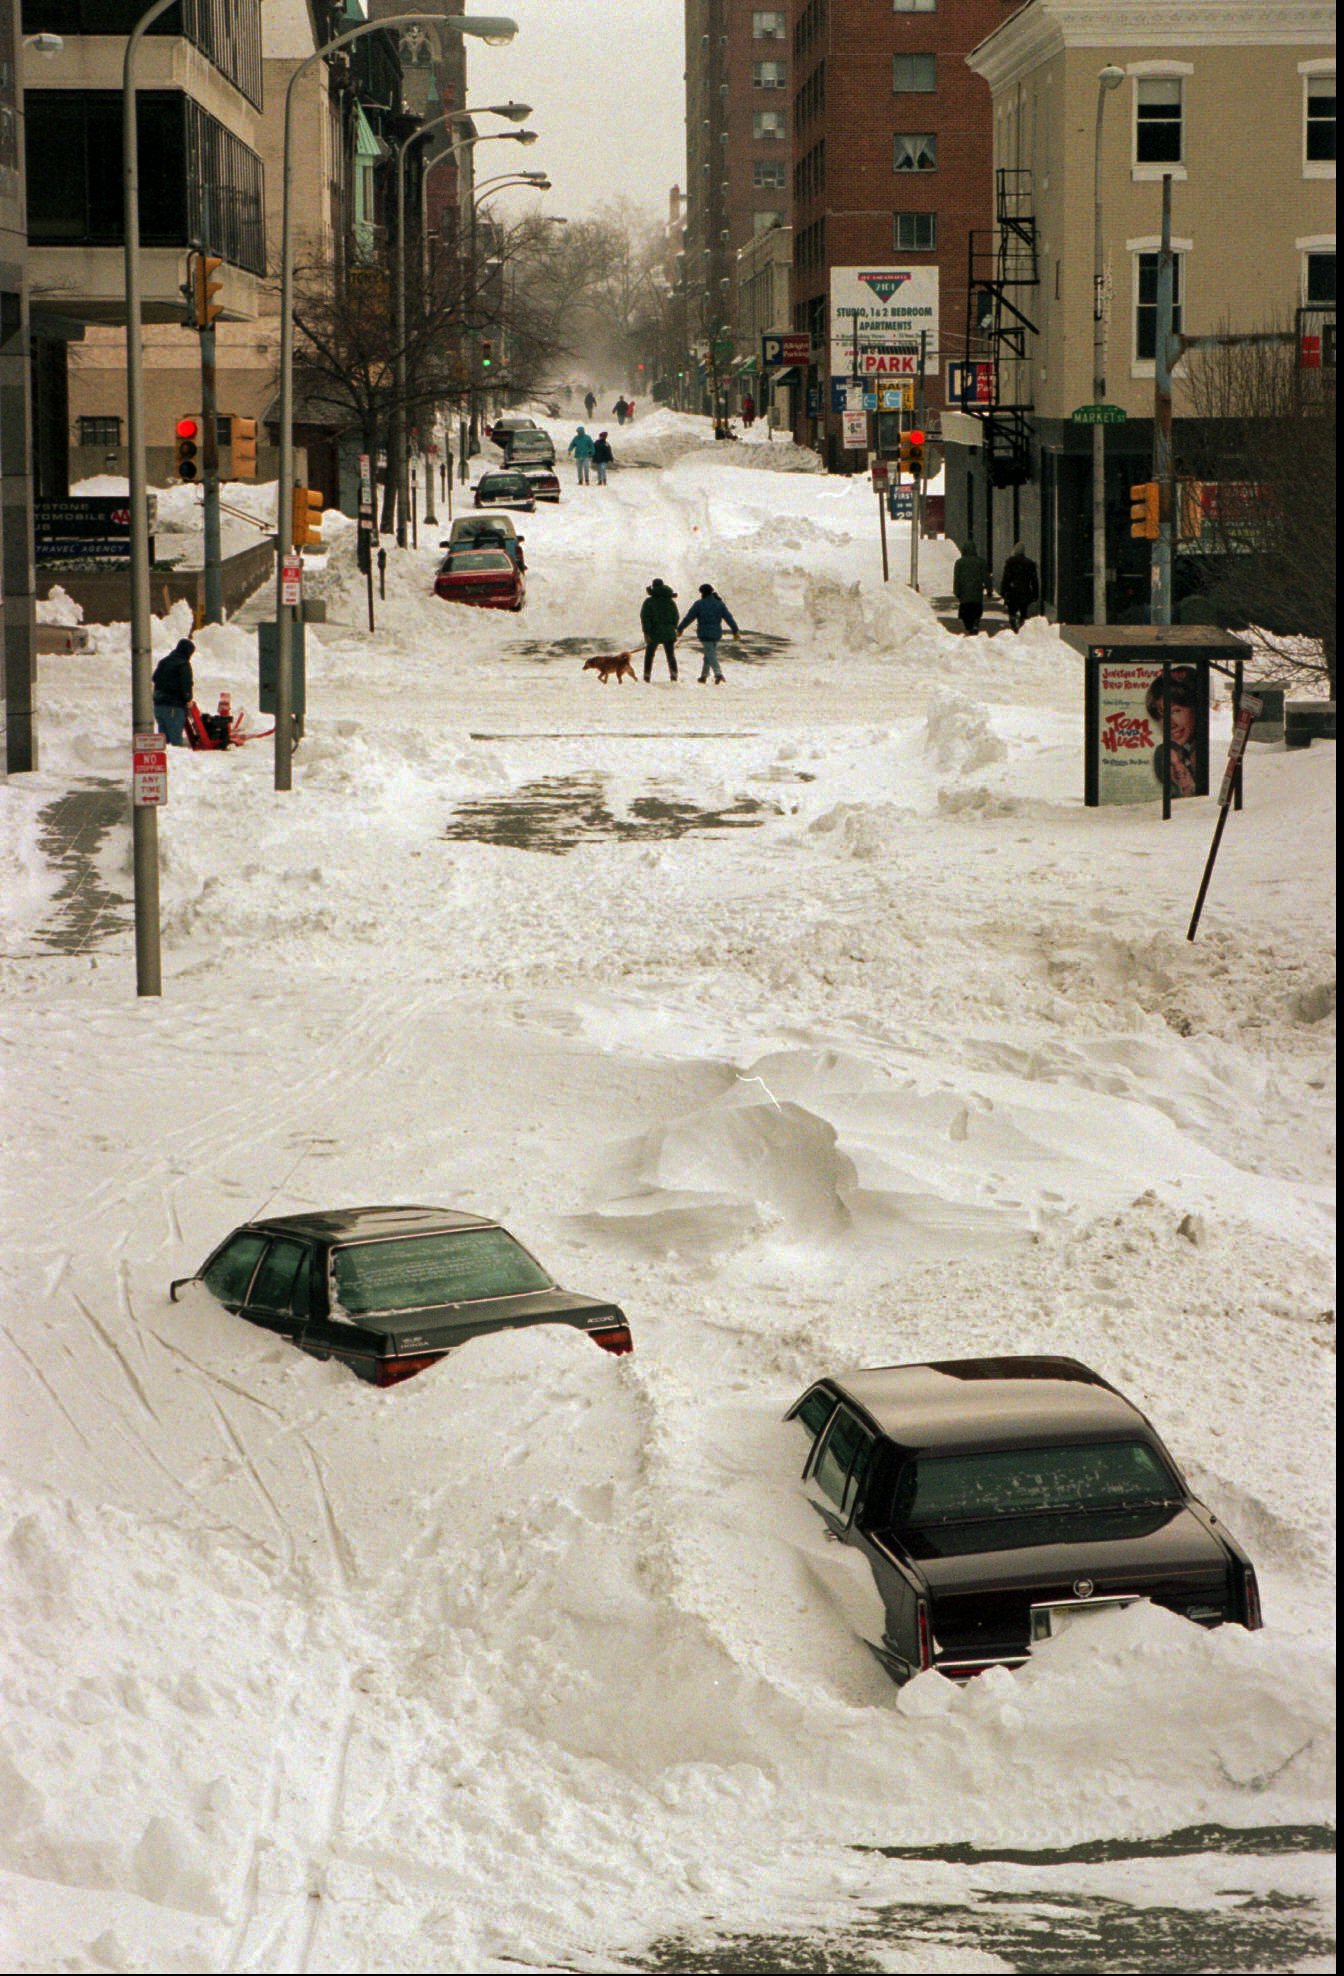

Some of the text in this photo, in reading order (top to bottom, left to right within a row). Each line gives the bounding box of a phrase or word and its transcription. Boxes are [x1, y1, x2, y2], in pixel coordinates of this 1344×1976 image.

[836, 307, 869, 318] STUDIO,
[882, 307, 889, 316] 2
[891, 306, 933, 317] BEDROOM
[859, 321, 912, 330] APARTMENTS
[766, 340, 779, 361] P
[865, 356, 914, 372] PARK
[1074, 412, 1114, 424] MARKET
[33, 503, 89, 511] YSTONE
[33, 513, 106, 521] TOMOBILE
[35, 545, 125, 553] TRAVEL AGENCY
[1102, 727, 1155, 752] HUCK
[143, 754, 157, 765] NO
